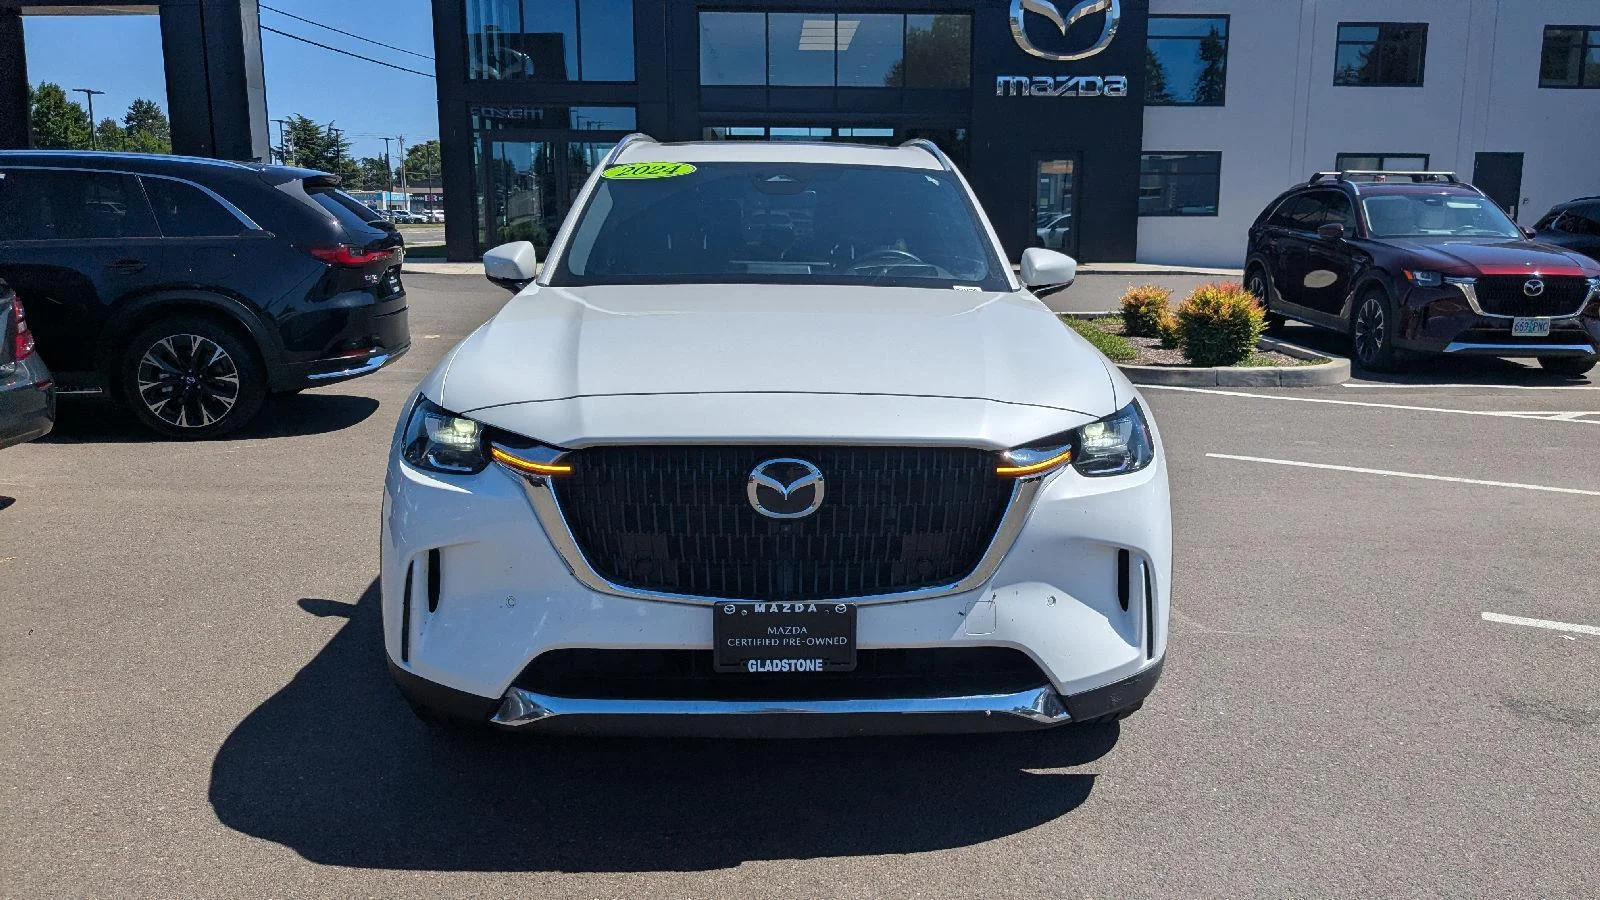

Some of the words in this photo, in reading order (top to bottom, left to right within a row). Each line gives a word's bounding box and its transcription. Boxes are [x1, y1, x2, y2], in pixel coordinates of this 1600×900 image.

[615, 164, 682, 177] 2024
[754, 603, 818, 613] MAZDA
[767, 626, 808, 635] MAZDA
[727, 638, 780, 647] CERTIFIED
[783, 636, 848, 646] PRE-OWNED
[747, 658, 824, 672] GLADSTONE
